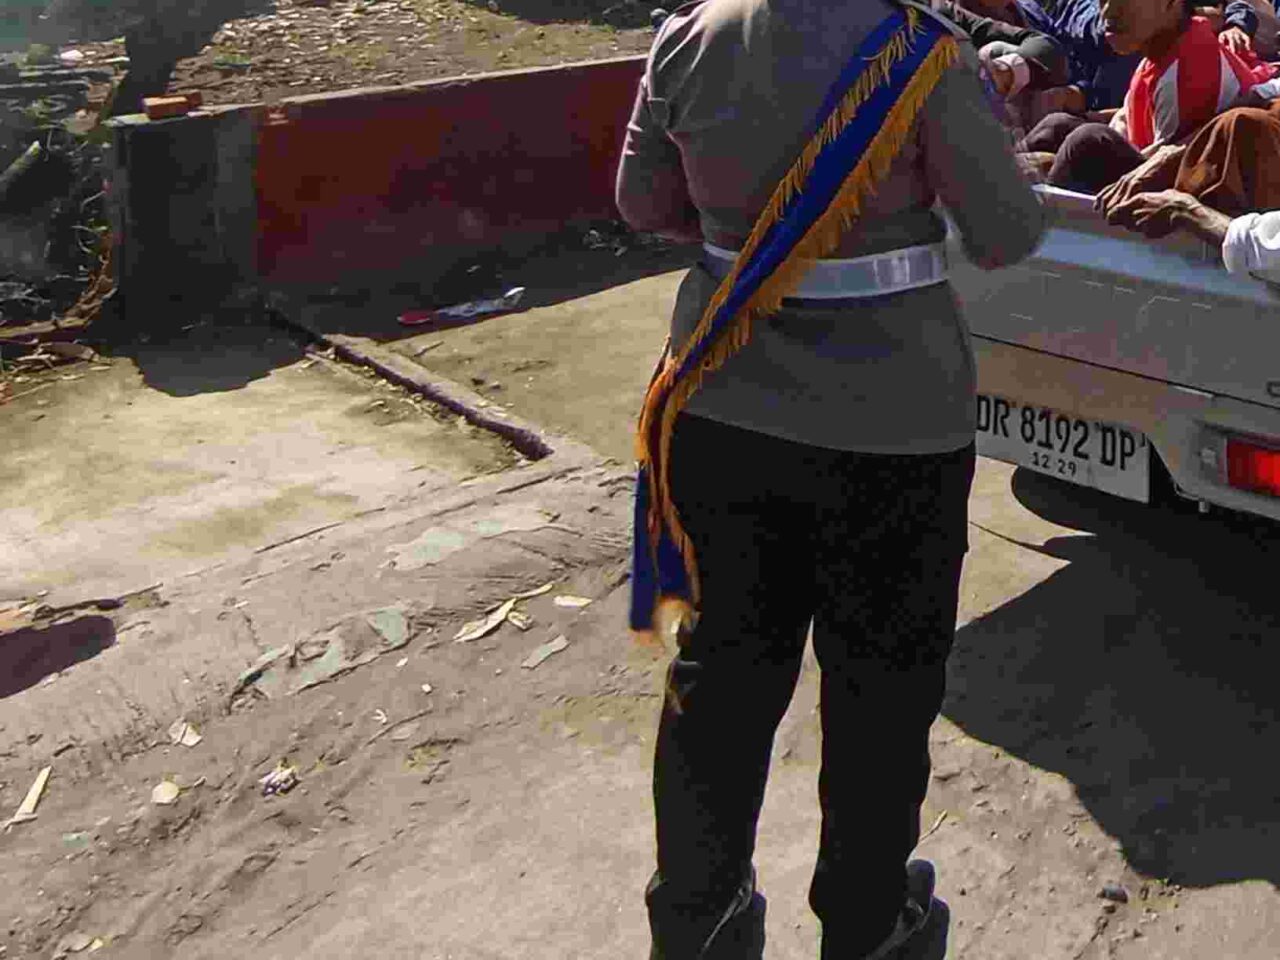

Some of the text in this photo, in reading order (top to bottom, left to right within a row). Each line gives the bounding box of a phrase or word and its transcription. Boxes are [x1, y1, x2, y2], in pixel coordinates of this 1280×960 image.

[976, 395, 1136, 470] DR 8192 DP
[1032, 451, 1077, 477] 12 29
